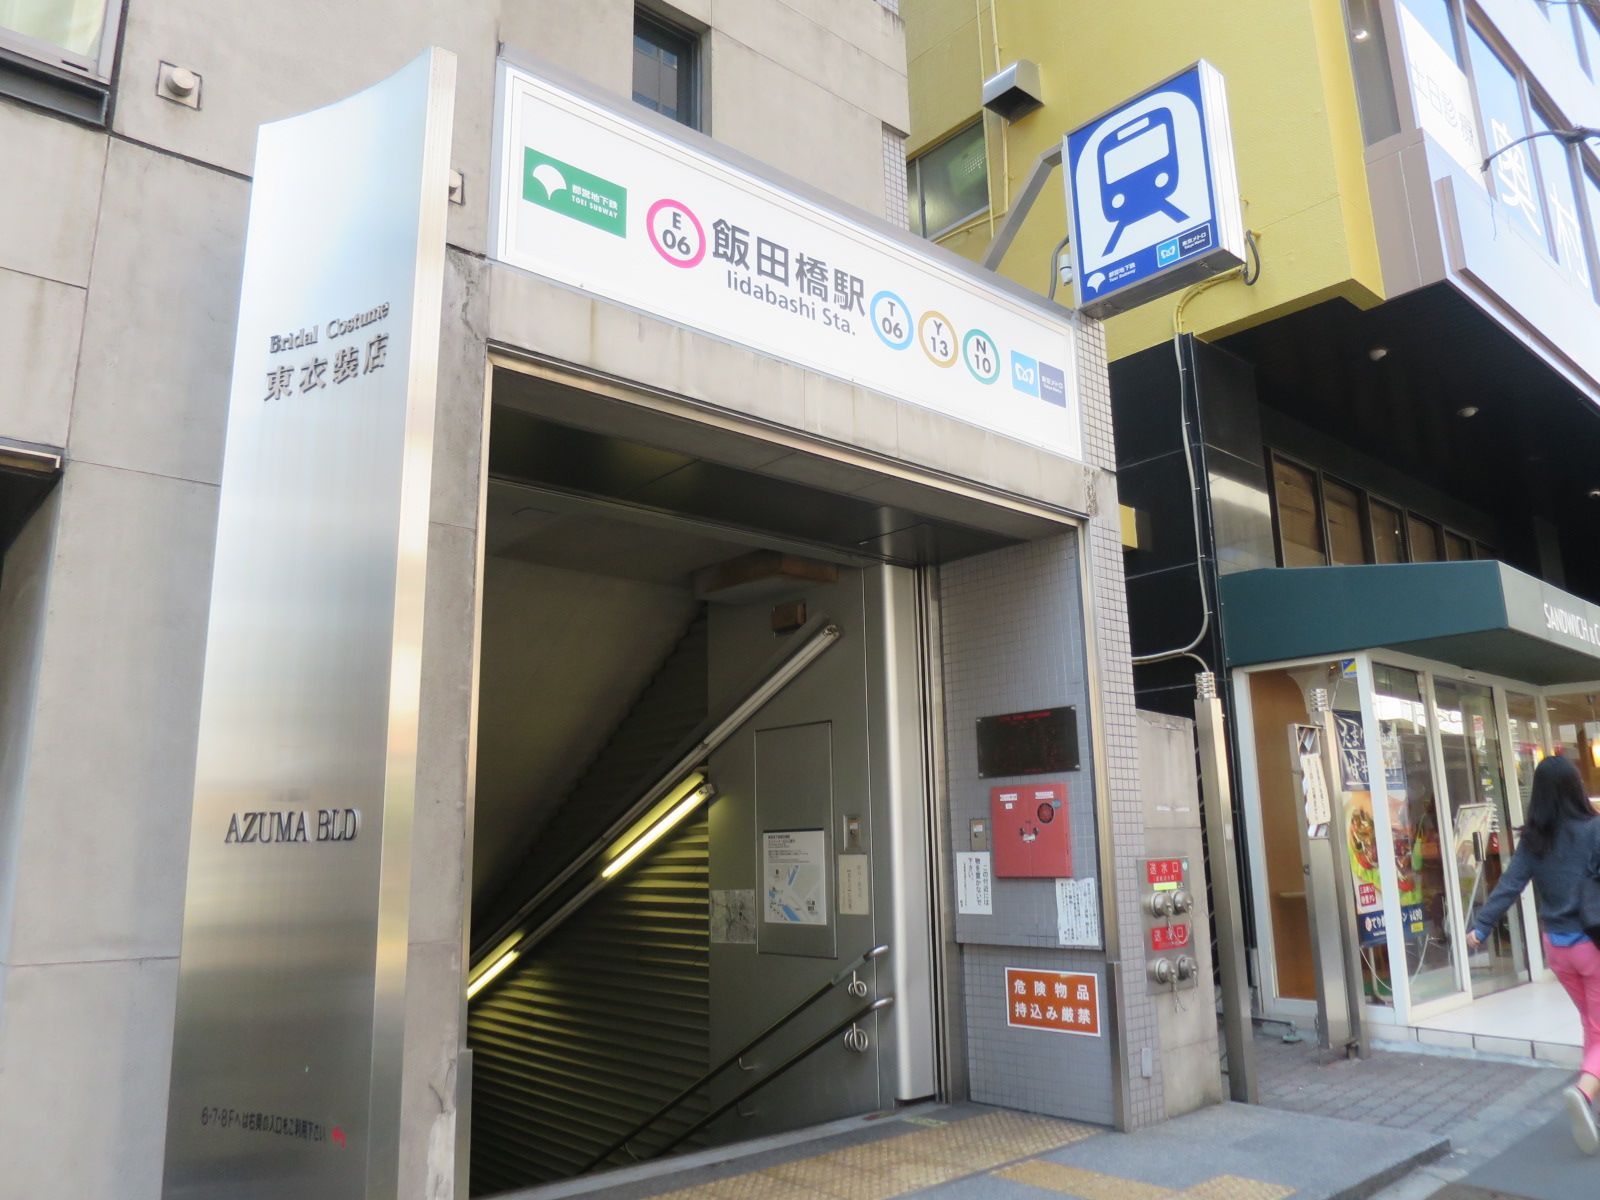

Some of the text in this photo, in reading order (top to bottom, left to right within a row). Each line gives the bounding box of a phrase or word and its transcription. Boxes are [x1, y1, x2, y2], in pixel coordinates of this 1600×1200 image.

[672, 211, 682, 231] E
[662, 229, 691, 256] 06
[712, 218, 866, 317] 飯田橋駅
[727, 270, 856, 336] Iidabashi Sta.
[887, 301, 896, 317] T
[269, 302, 390, 354] Bridal Costume
[882, 318, 903, 339] 06
[932, 320, 943, 335] Y
[930, 336, 949, 357] 13
[976, 338, 987, 355] N
[974, 354, 991, 374] 10
[1543, 602, 1590, 642] SANDWICH
[225, 808, 360, 844] AZUMA BLD
[1014, 979, 1089, 1001] 危険物品
[1014, 1001, 1091, 1025] 持込み厳禁
